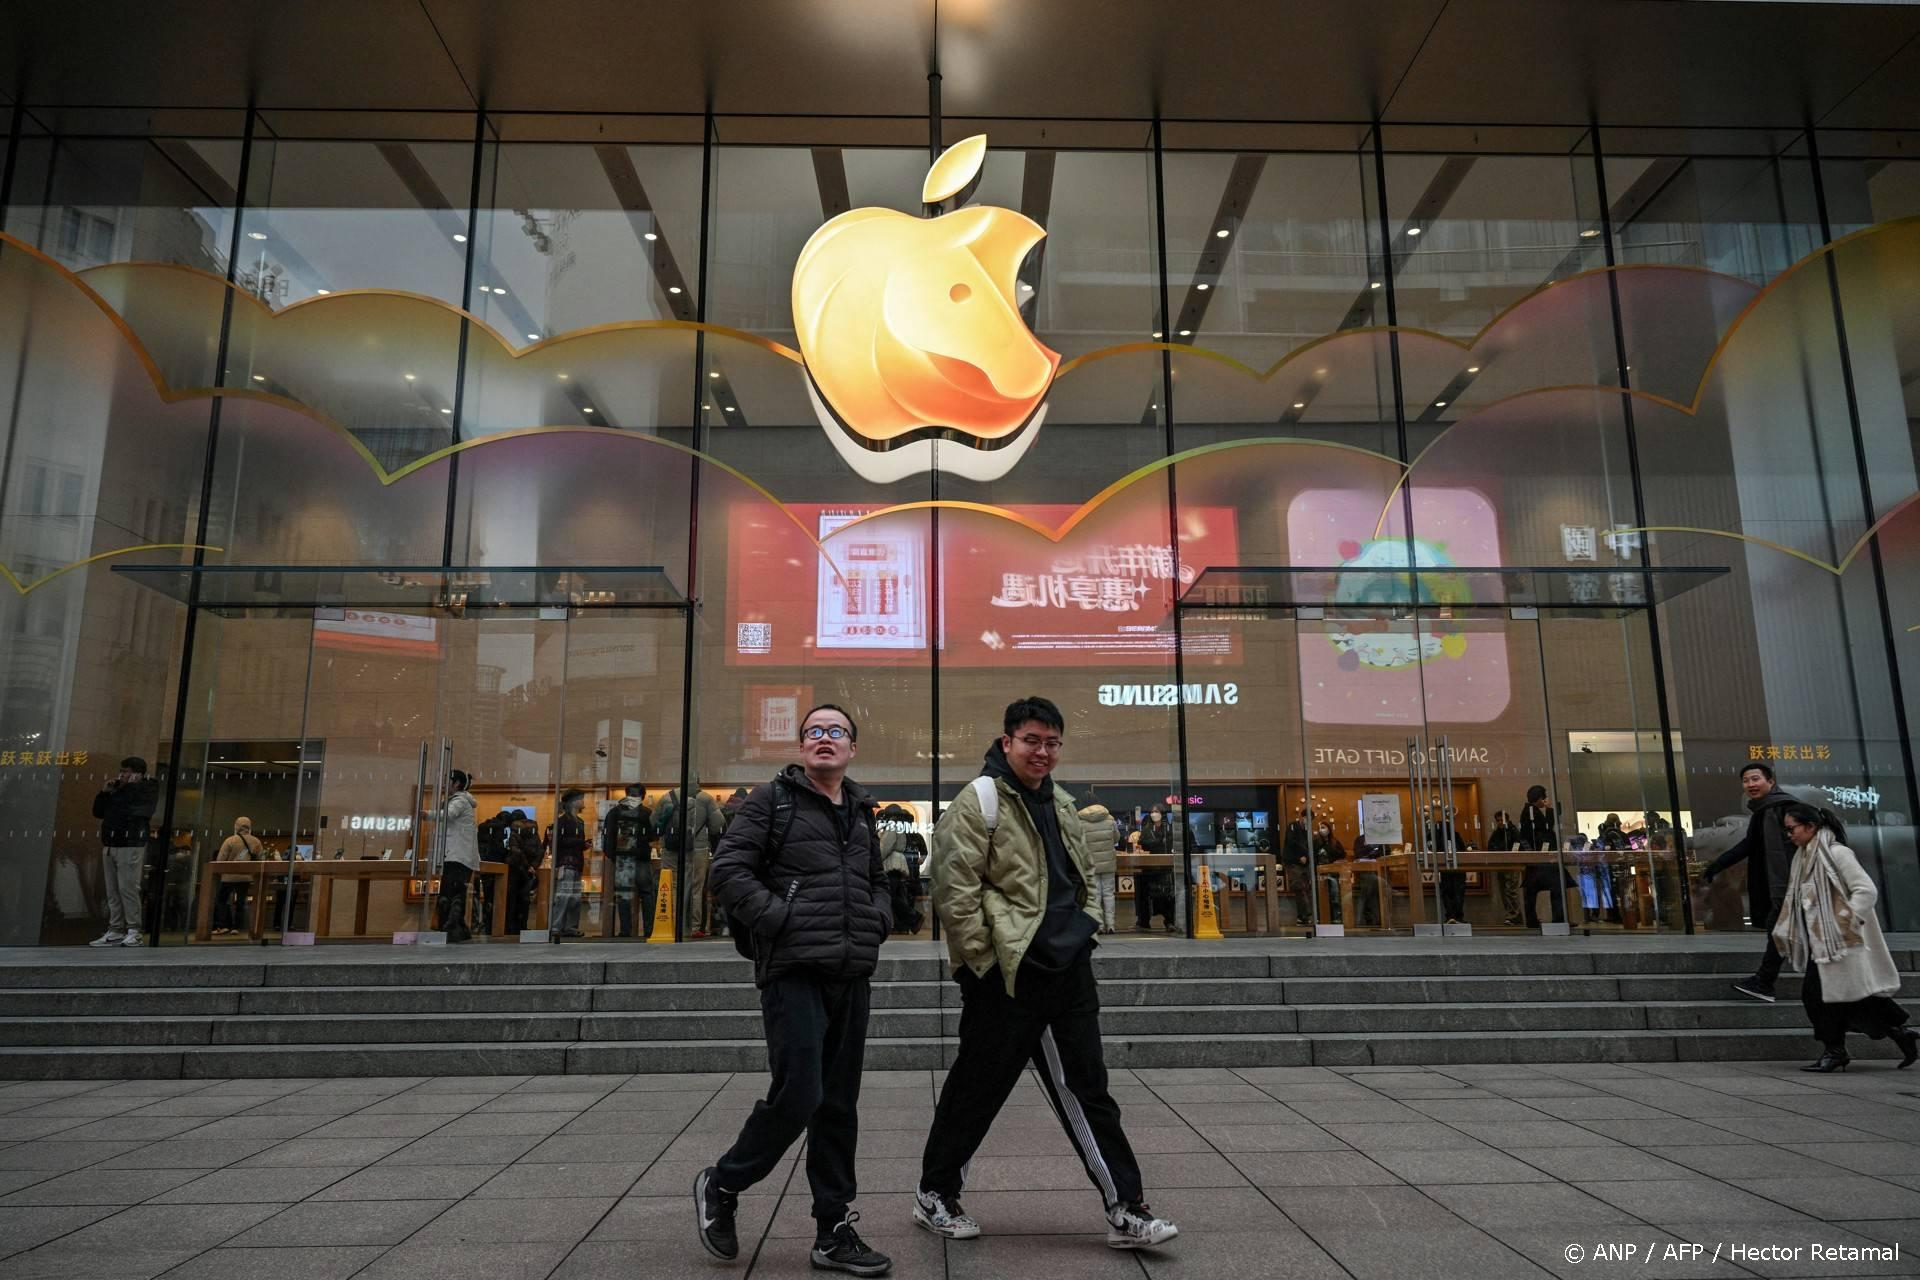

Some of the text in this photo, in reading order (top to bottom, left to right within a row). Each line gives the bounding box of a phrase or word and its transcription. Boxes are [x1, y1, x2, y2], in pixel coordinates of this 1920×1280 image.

[1749, 745, 1832, 760] 跃来跃出彩
[1172, 794, 1204, 805] Msic
